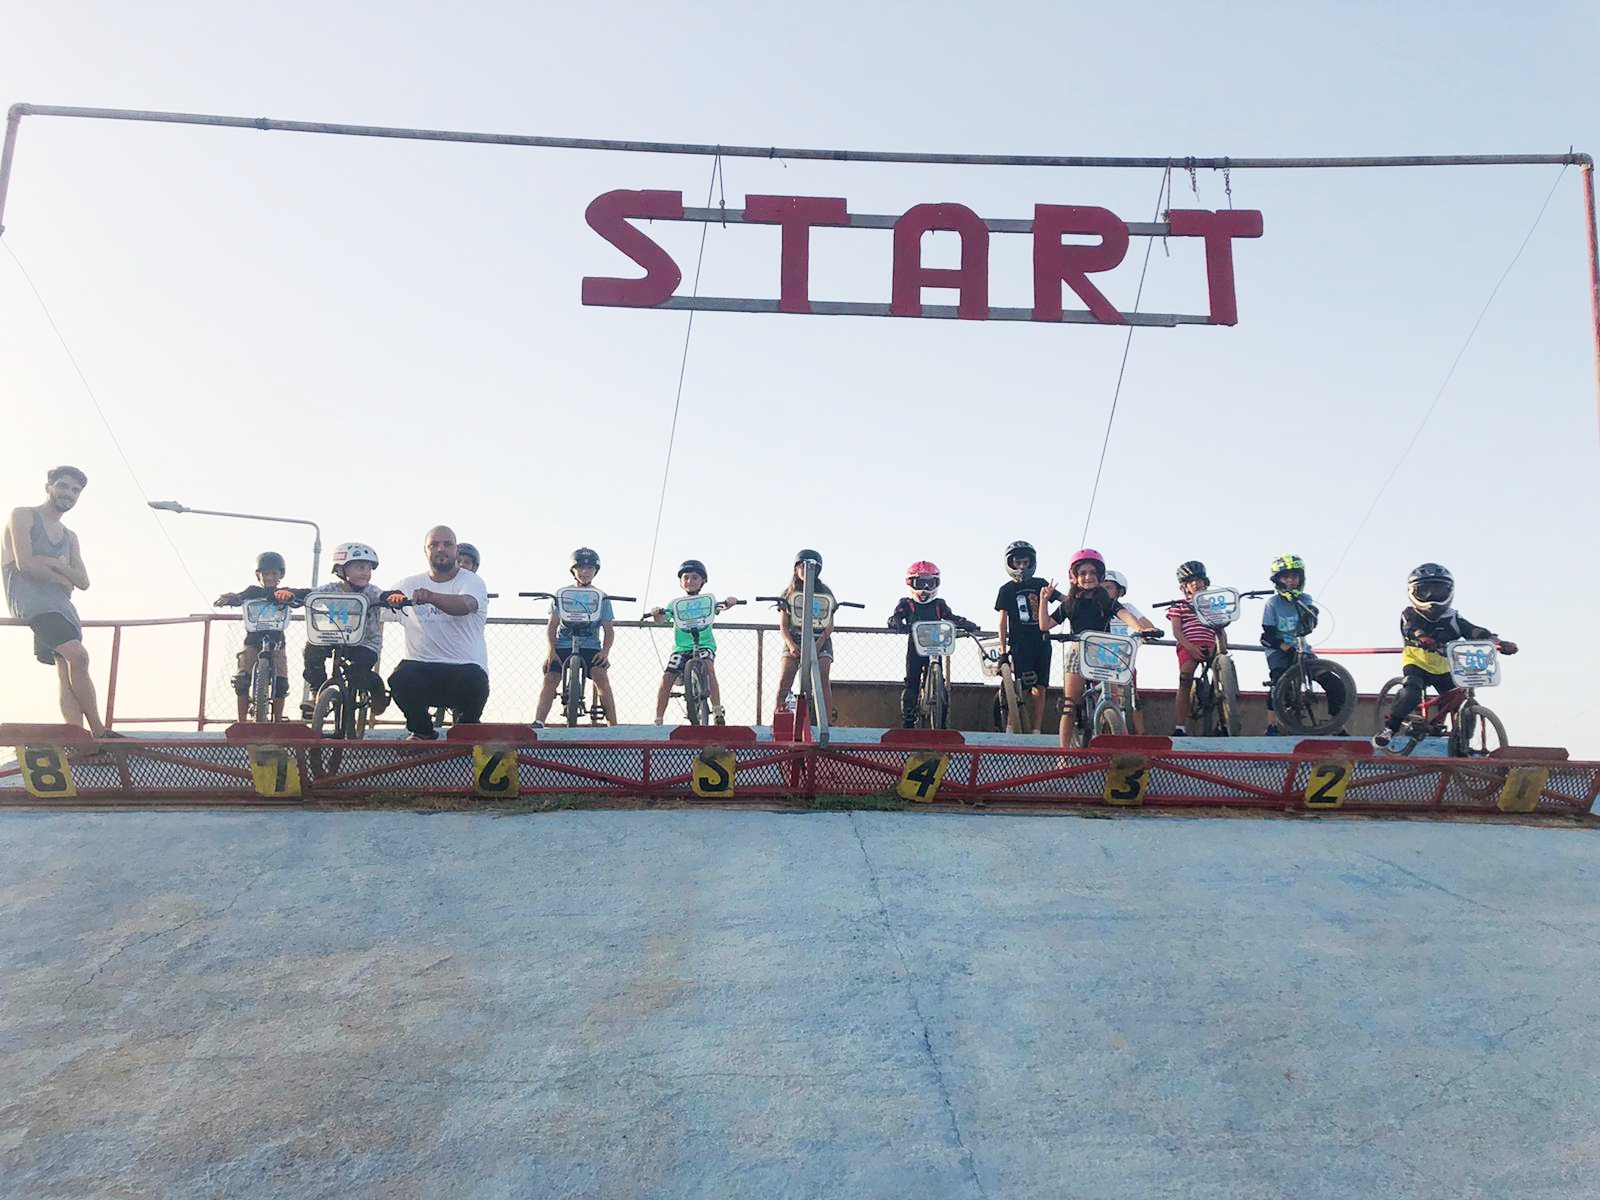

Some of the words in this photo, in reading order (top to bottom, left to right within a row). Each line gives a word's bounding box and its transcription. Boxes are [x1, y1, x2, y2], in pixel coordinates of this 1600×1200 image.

[582, 189, 1263, 326] START
[328, 602, 349, 624] 14
[25, 750, 67, 791] 8
[478, 752, 510, 791] 6
[906, 759, 939, 796] 4
[1309, 765, 1346, 804] 2
